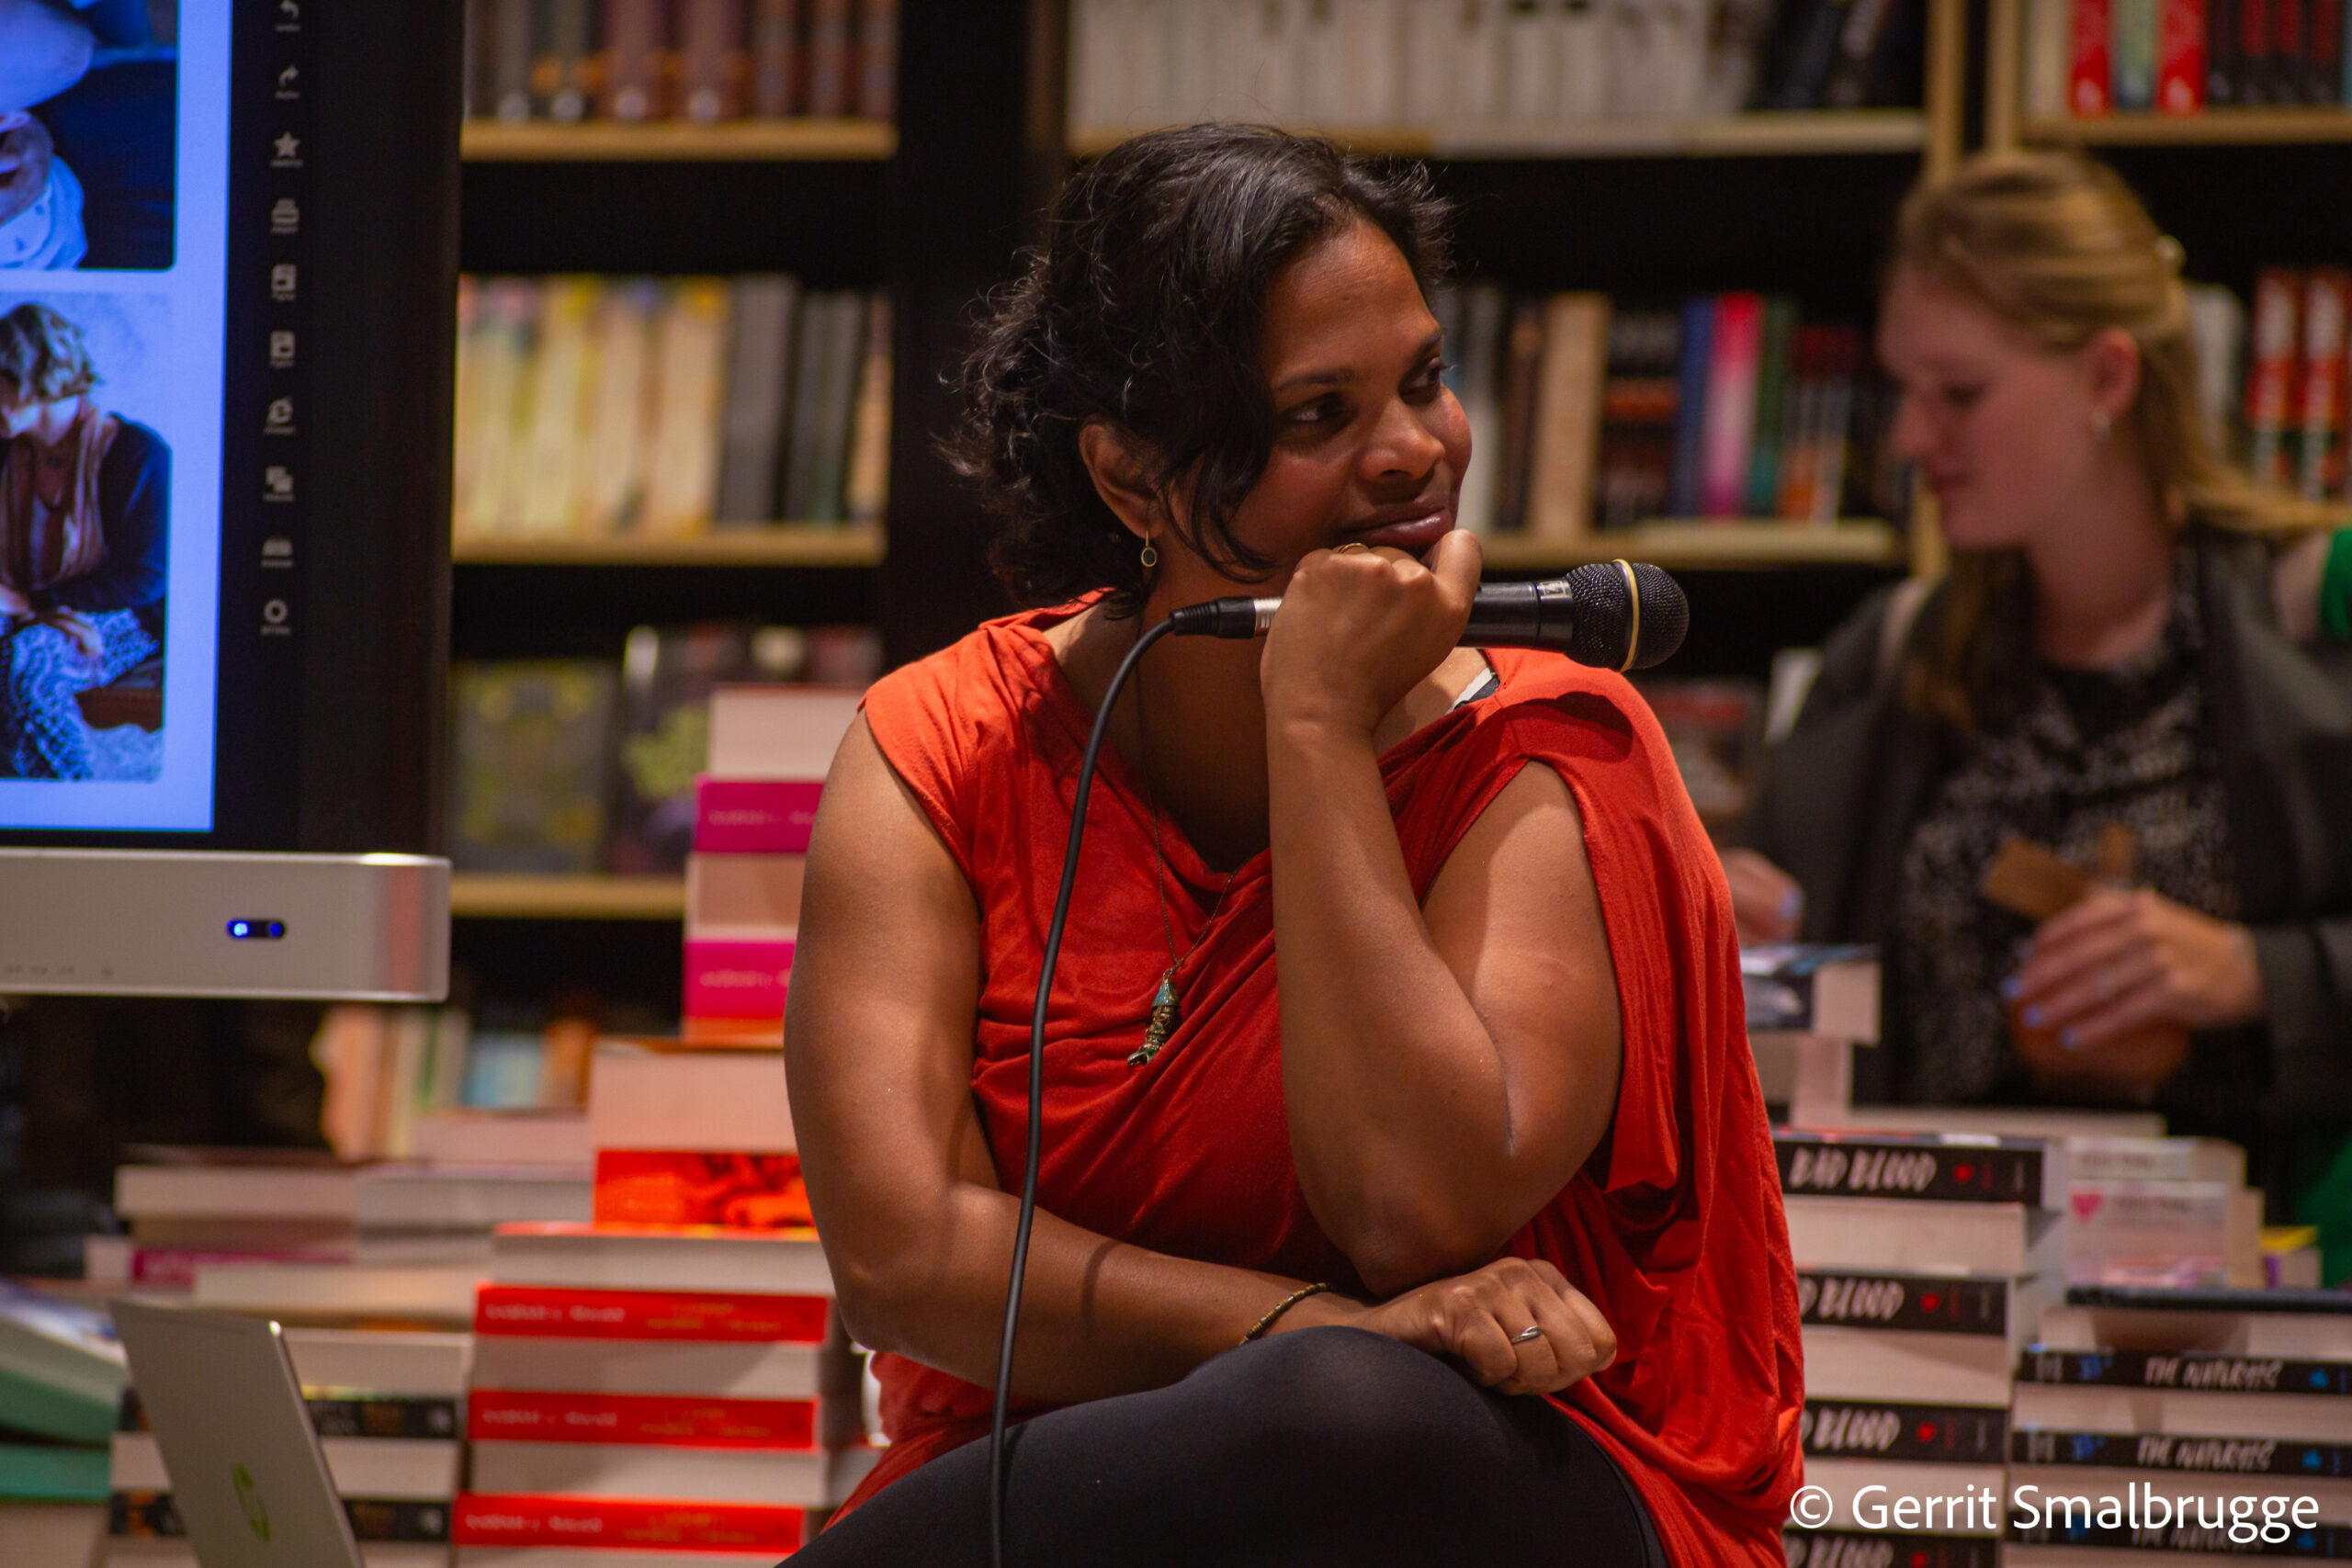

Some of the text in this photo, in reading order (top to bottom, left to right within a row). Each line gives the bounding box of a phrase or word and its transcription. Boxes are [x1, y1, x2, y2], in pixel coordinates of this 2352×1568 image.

[1788, 1145, 1848, 1190] BAD
[1848, 1148, 1937, 1192] BLOOD
[1817, 1277, 1905, 1322] BLOOD
[1812, 1406, 1901, 1452] BLOOD
